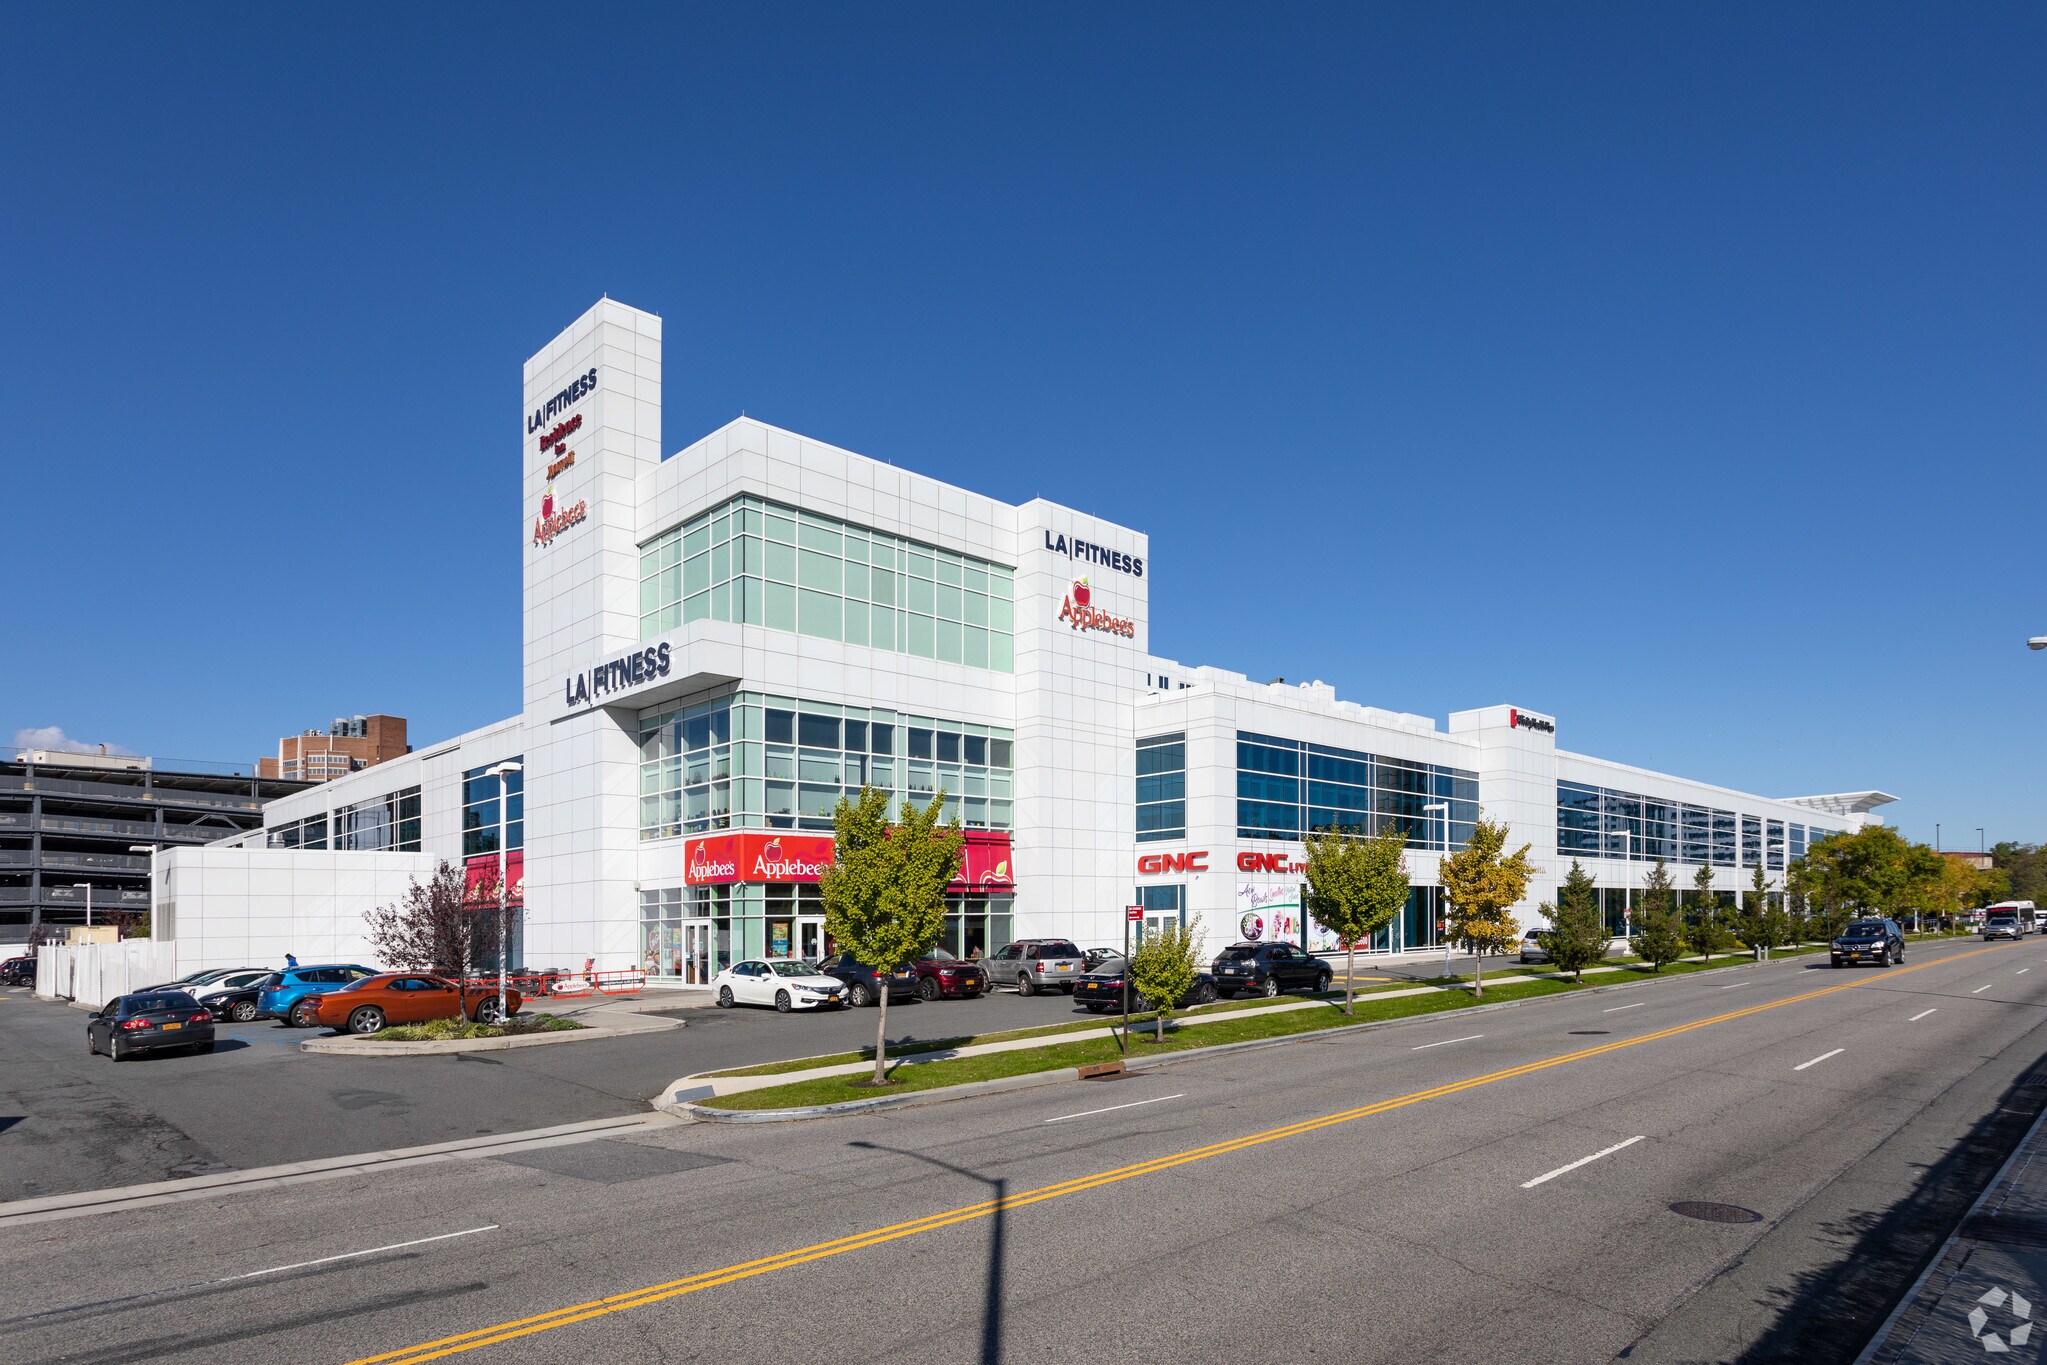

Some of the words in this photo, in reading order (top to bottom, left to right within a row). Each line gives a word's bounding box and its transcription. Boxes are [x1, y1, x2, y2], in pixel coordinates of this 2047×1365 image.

[546, 367, 598, 422] FITNESS
[533, 498, 587, 545] Applebee's
[1074, 539, 1143, 577] FITNESS
[1060, 594, 1135, 637] Applebee's
[593, 642, 671, 695] FITNESS
[688, 858, 735, 882] Applebee's
[1137, 851, 1209, 874] GNC
[1237, 851, 1289, 872] GNC
